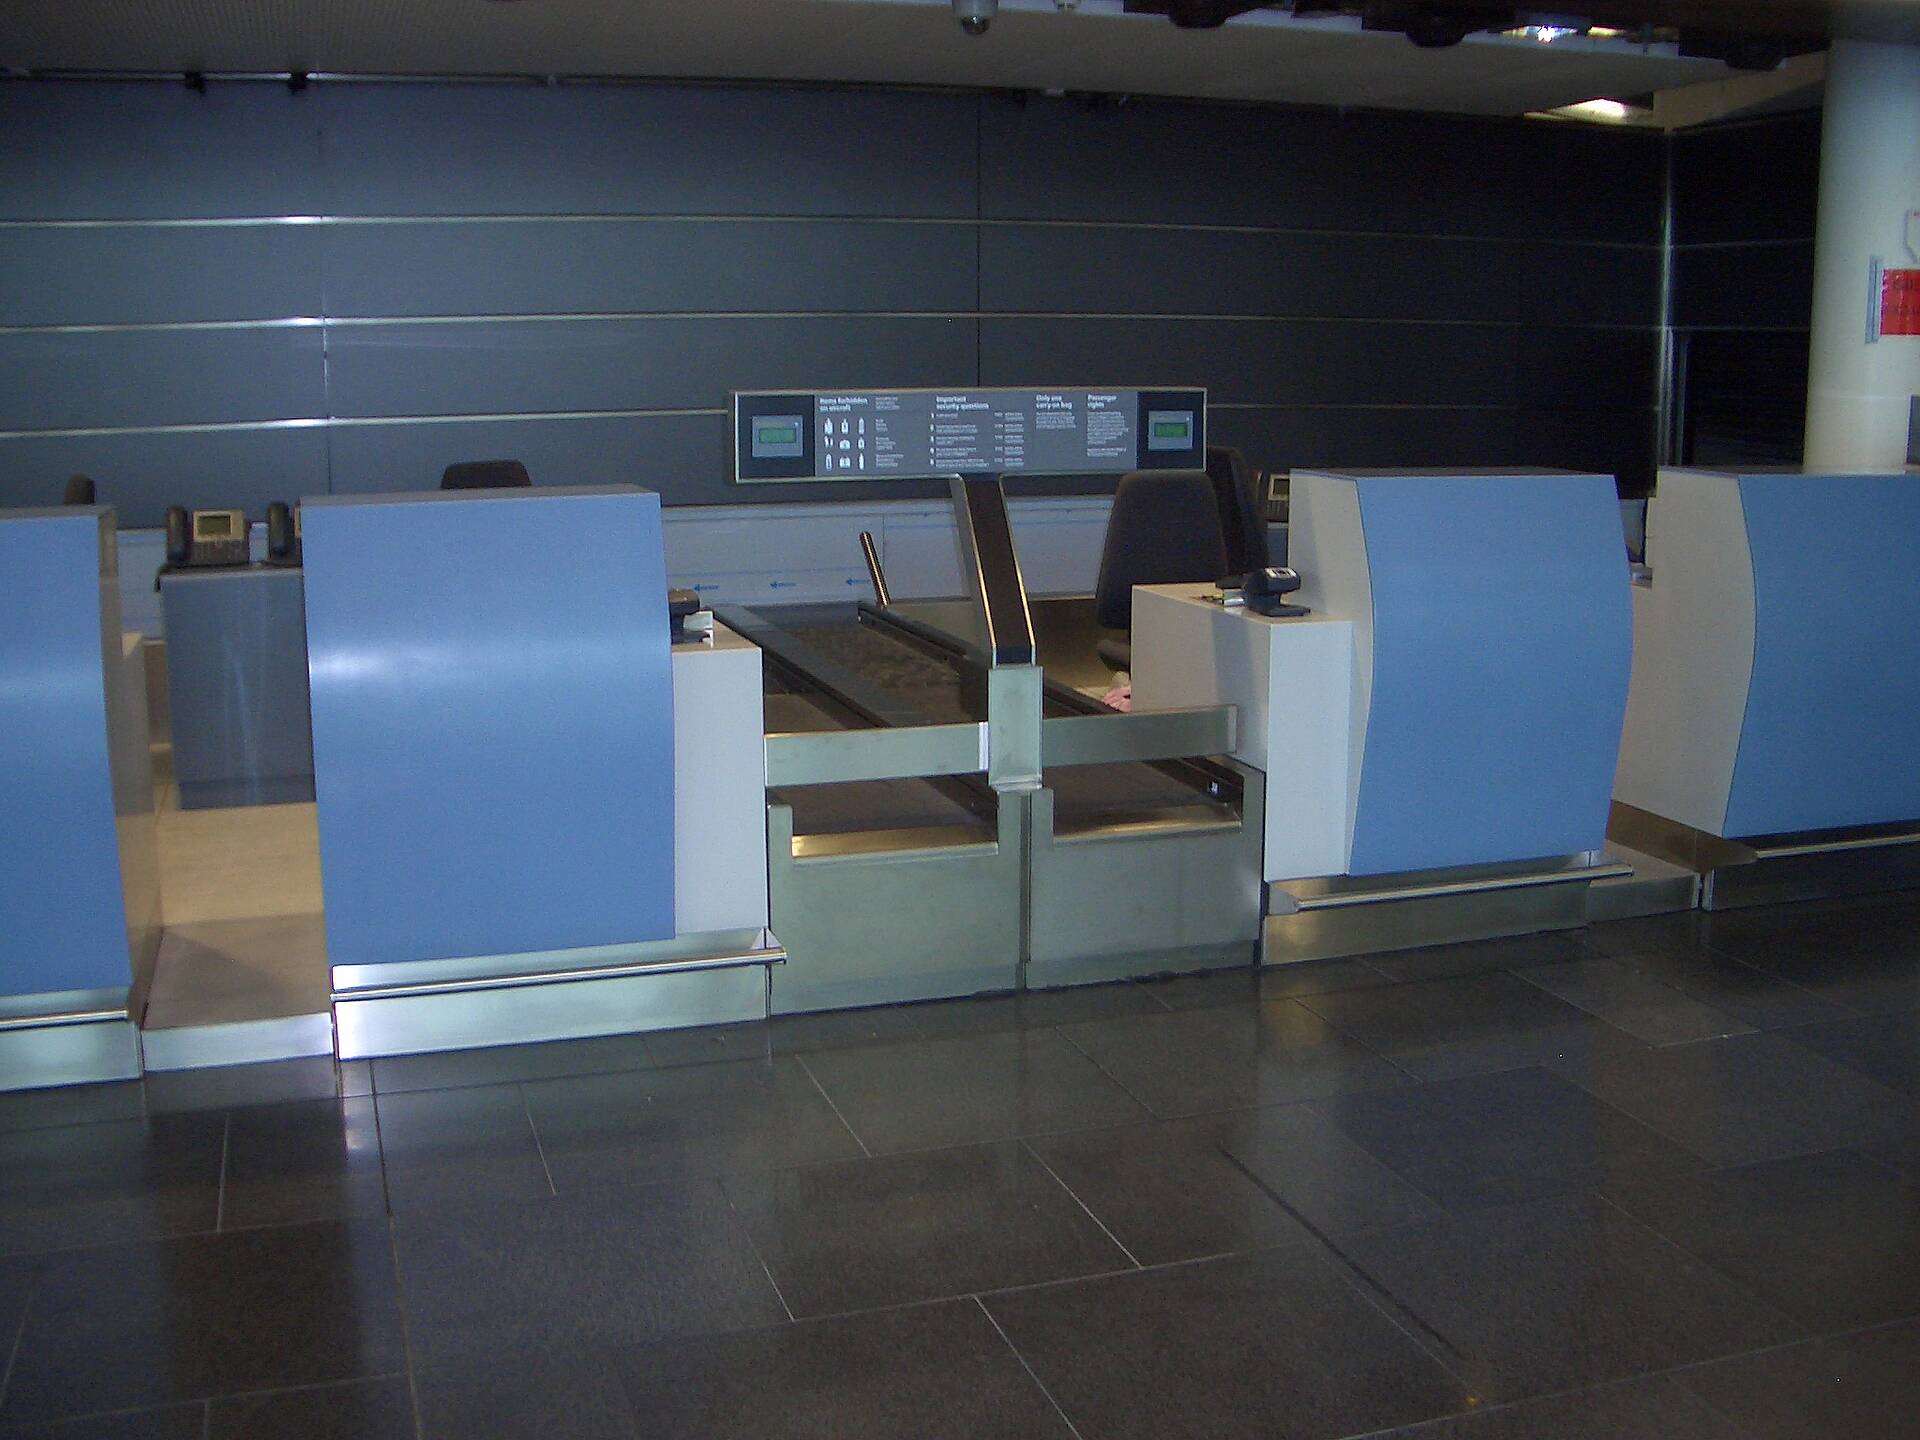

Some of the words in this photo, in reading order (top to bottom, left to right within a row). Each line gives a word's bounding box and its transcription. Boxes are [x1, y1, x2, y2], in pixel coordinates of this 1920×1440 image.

[936, 395, 966, 403] Important
[1088, 394, 1117, 402] Passenger
[936, 403, 959, 411] security
[960, 403, 989, 411] questions
